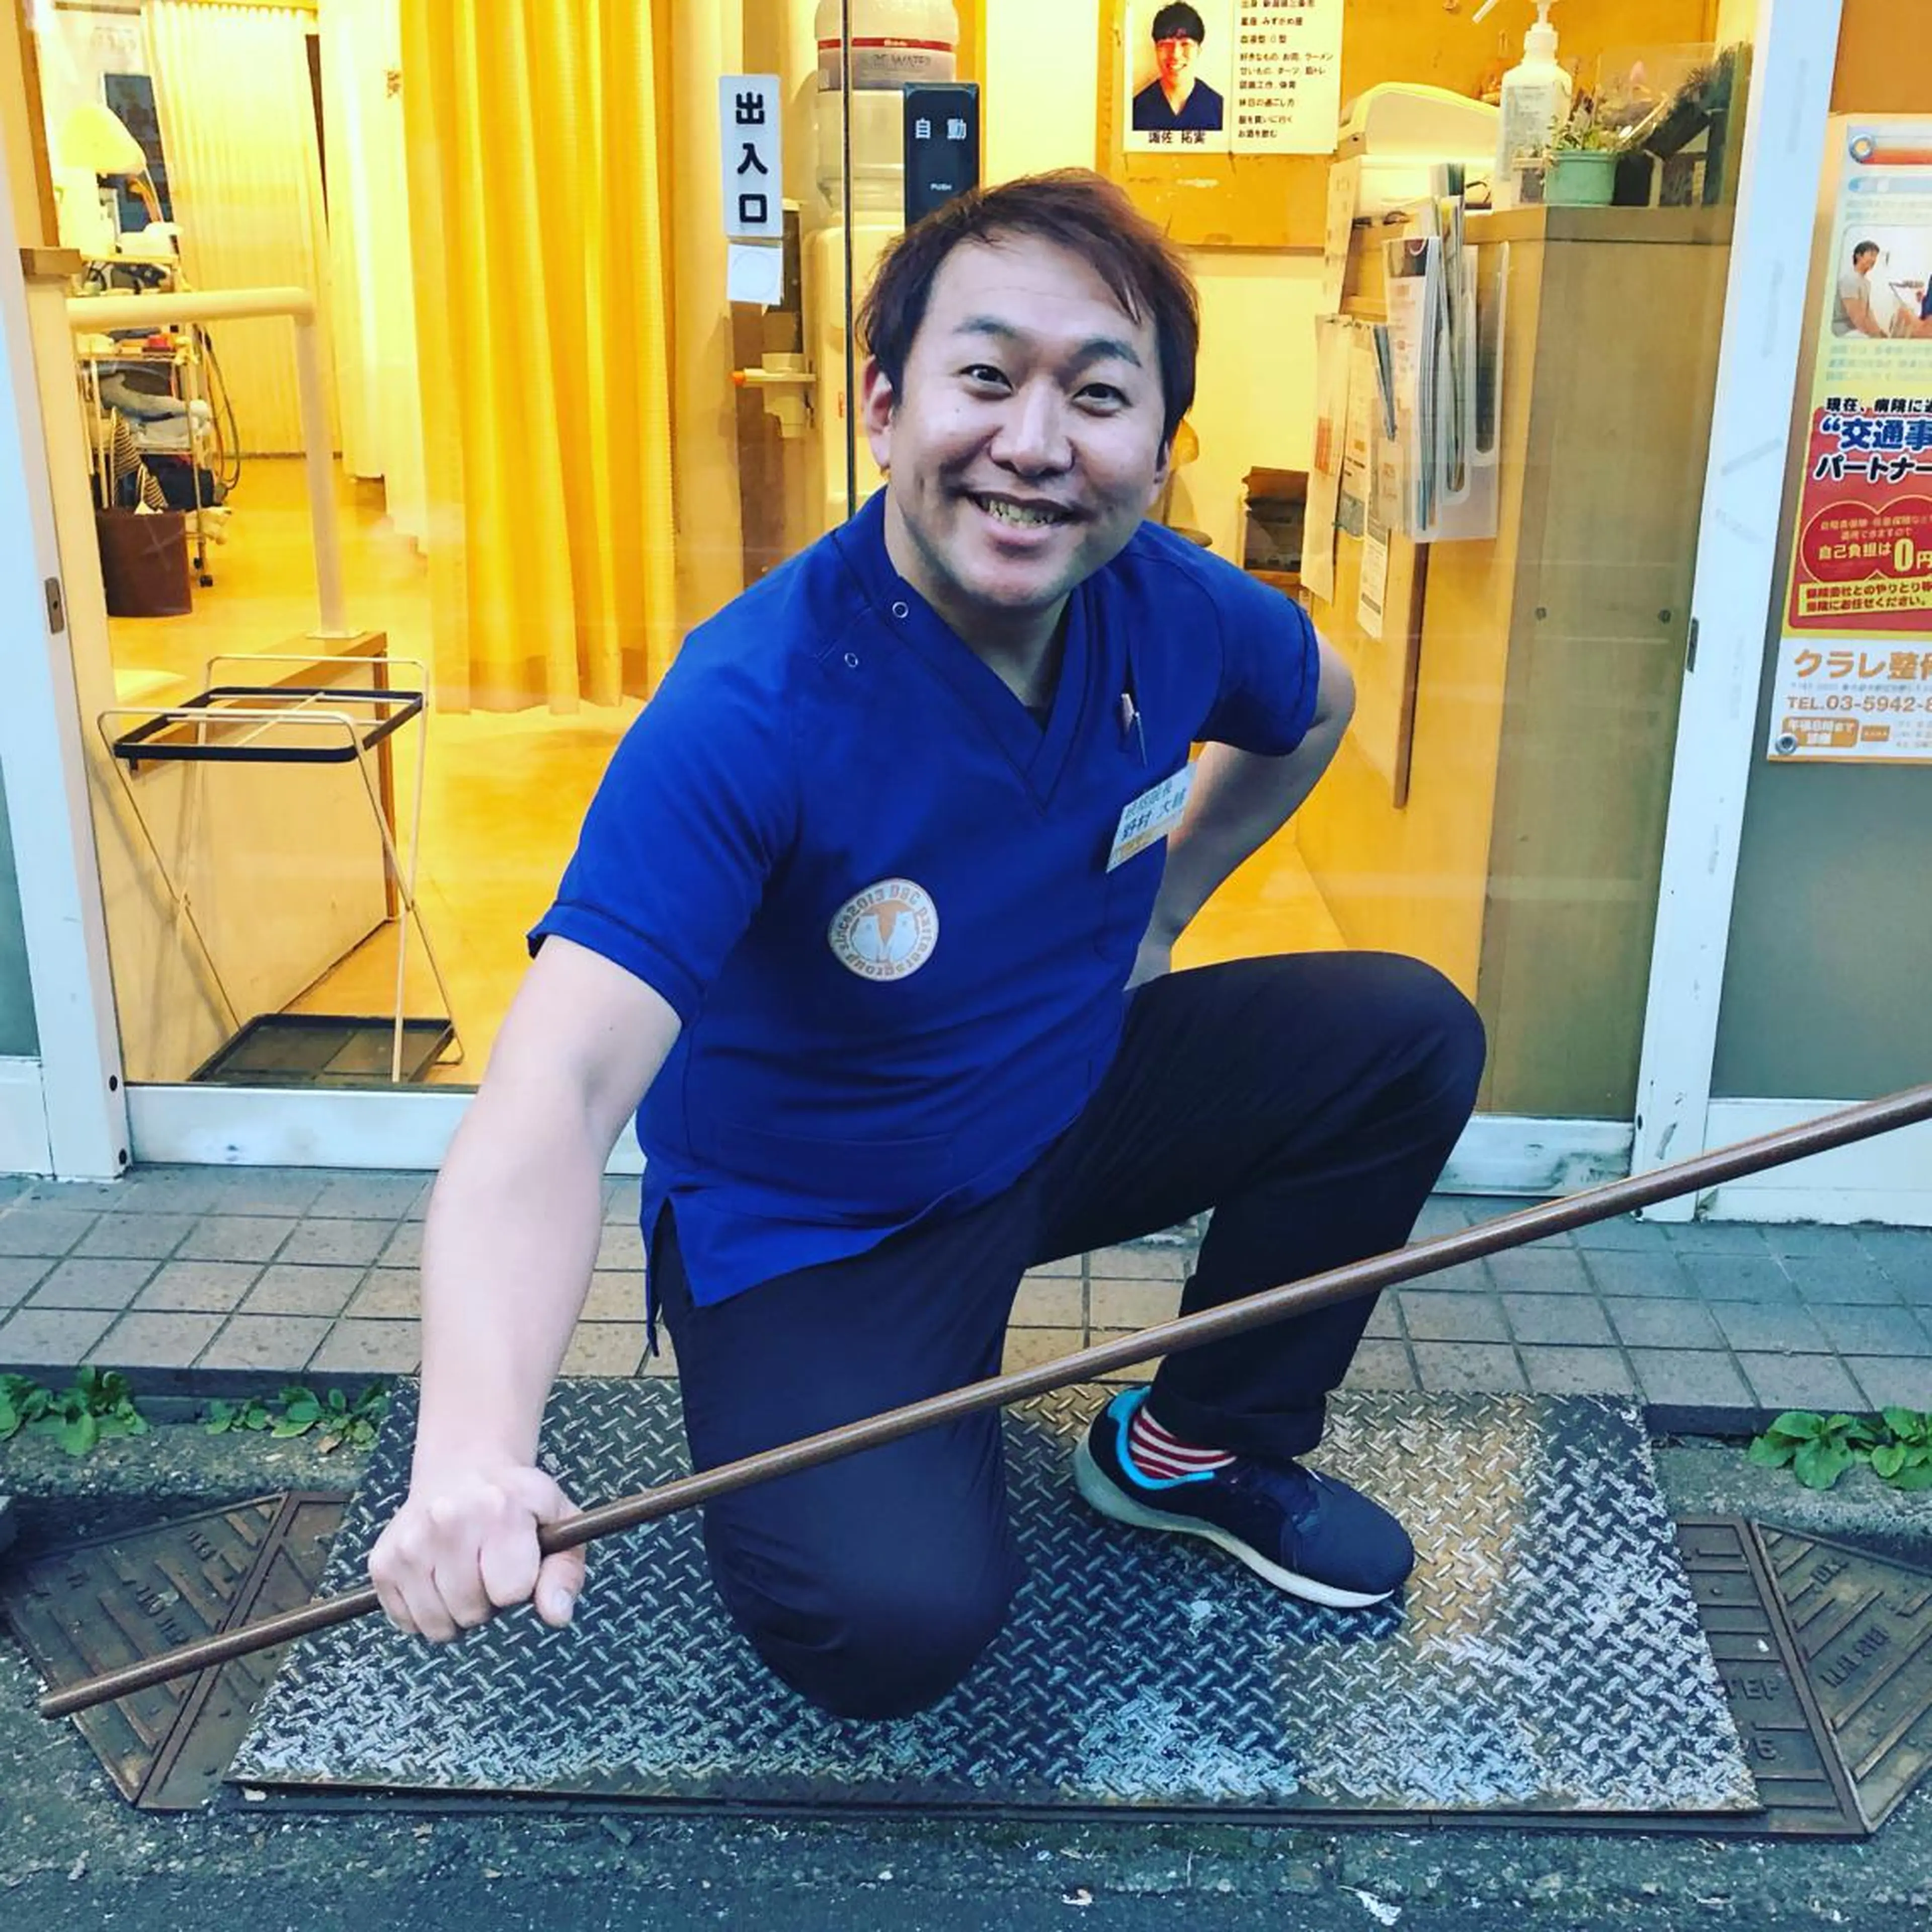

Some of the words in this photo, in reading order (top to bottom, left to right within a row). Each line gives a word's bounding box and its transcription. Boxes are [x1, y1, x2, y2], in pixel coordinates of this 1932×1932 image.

[736, 92, 768, 223] 出入口
[1815, 454, 1932, 480] パートナー
